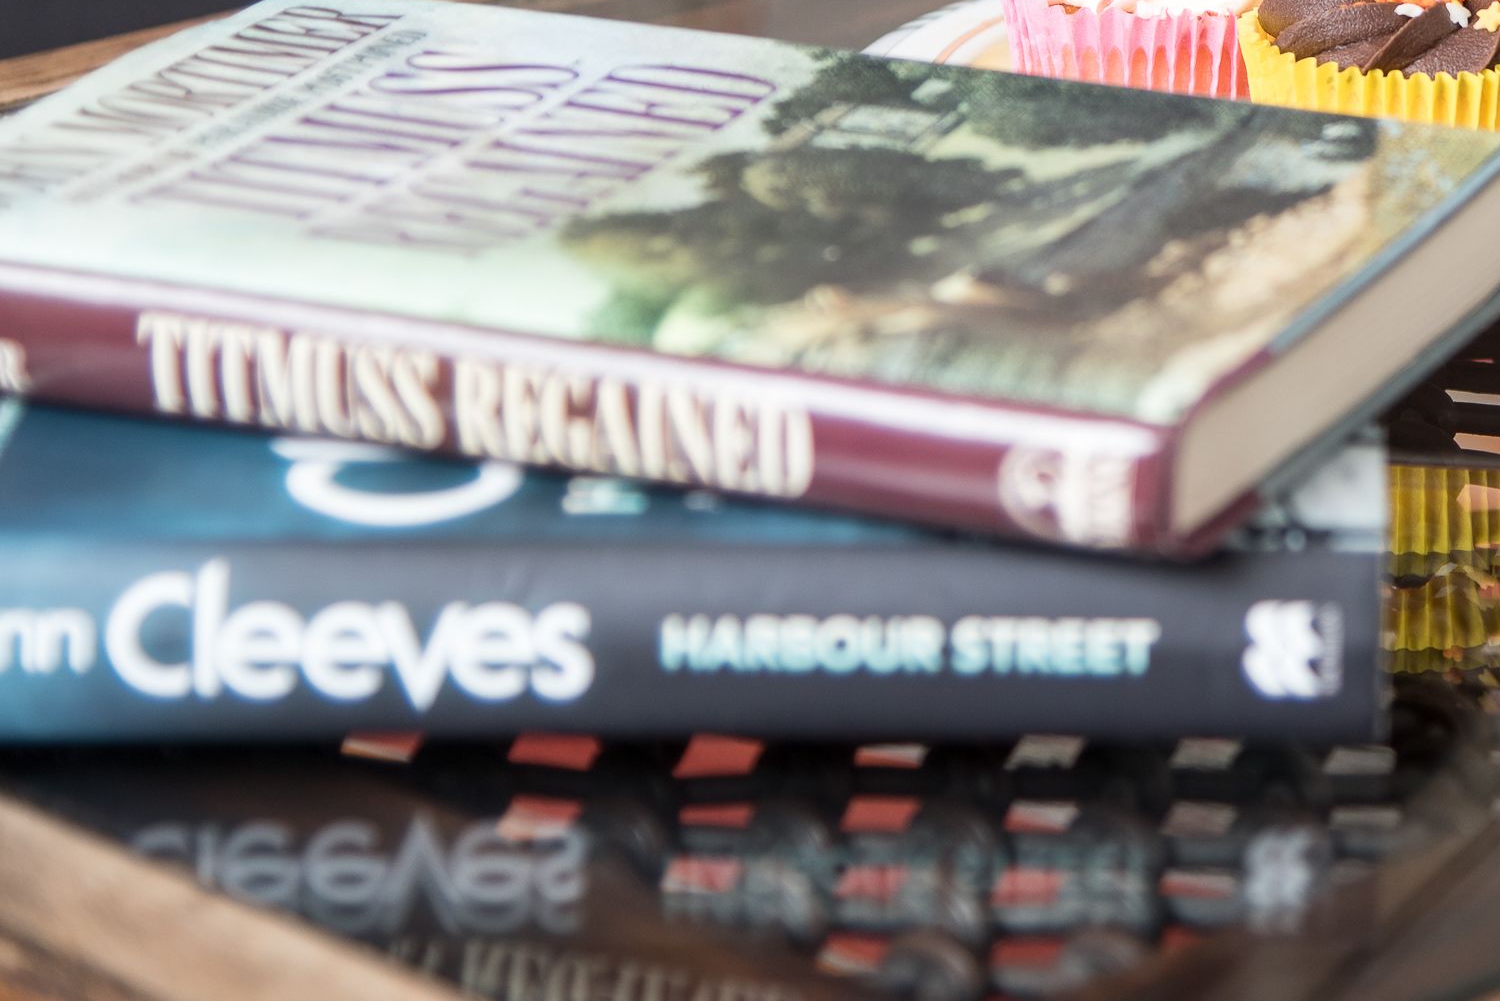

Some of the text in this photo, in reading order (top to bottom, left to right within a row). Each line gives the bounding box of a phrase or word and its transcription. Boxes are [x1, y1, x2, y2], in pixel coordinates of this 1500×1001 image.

[137, 311, 446, 450] TITMUSS
[455, 360, 815, 499] REGAINED
[104, 554, 597, 712] Cleeves
[659, 612, 1161, 677] HARBOUR STREET
